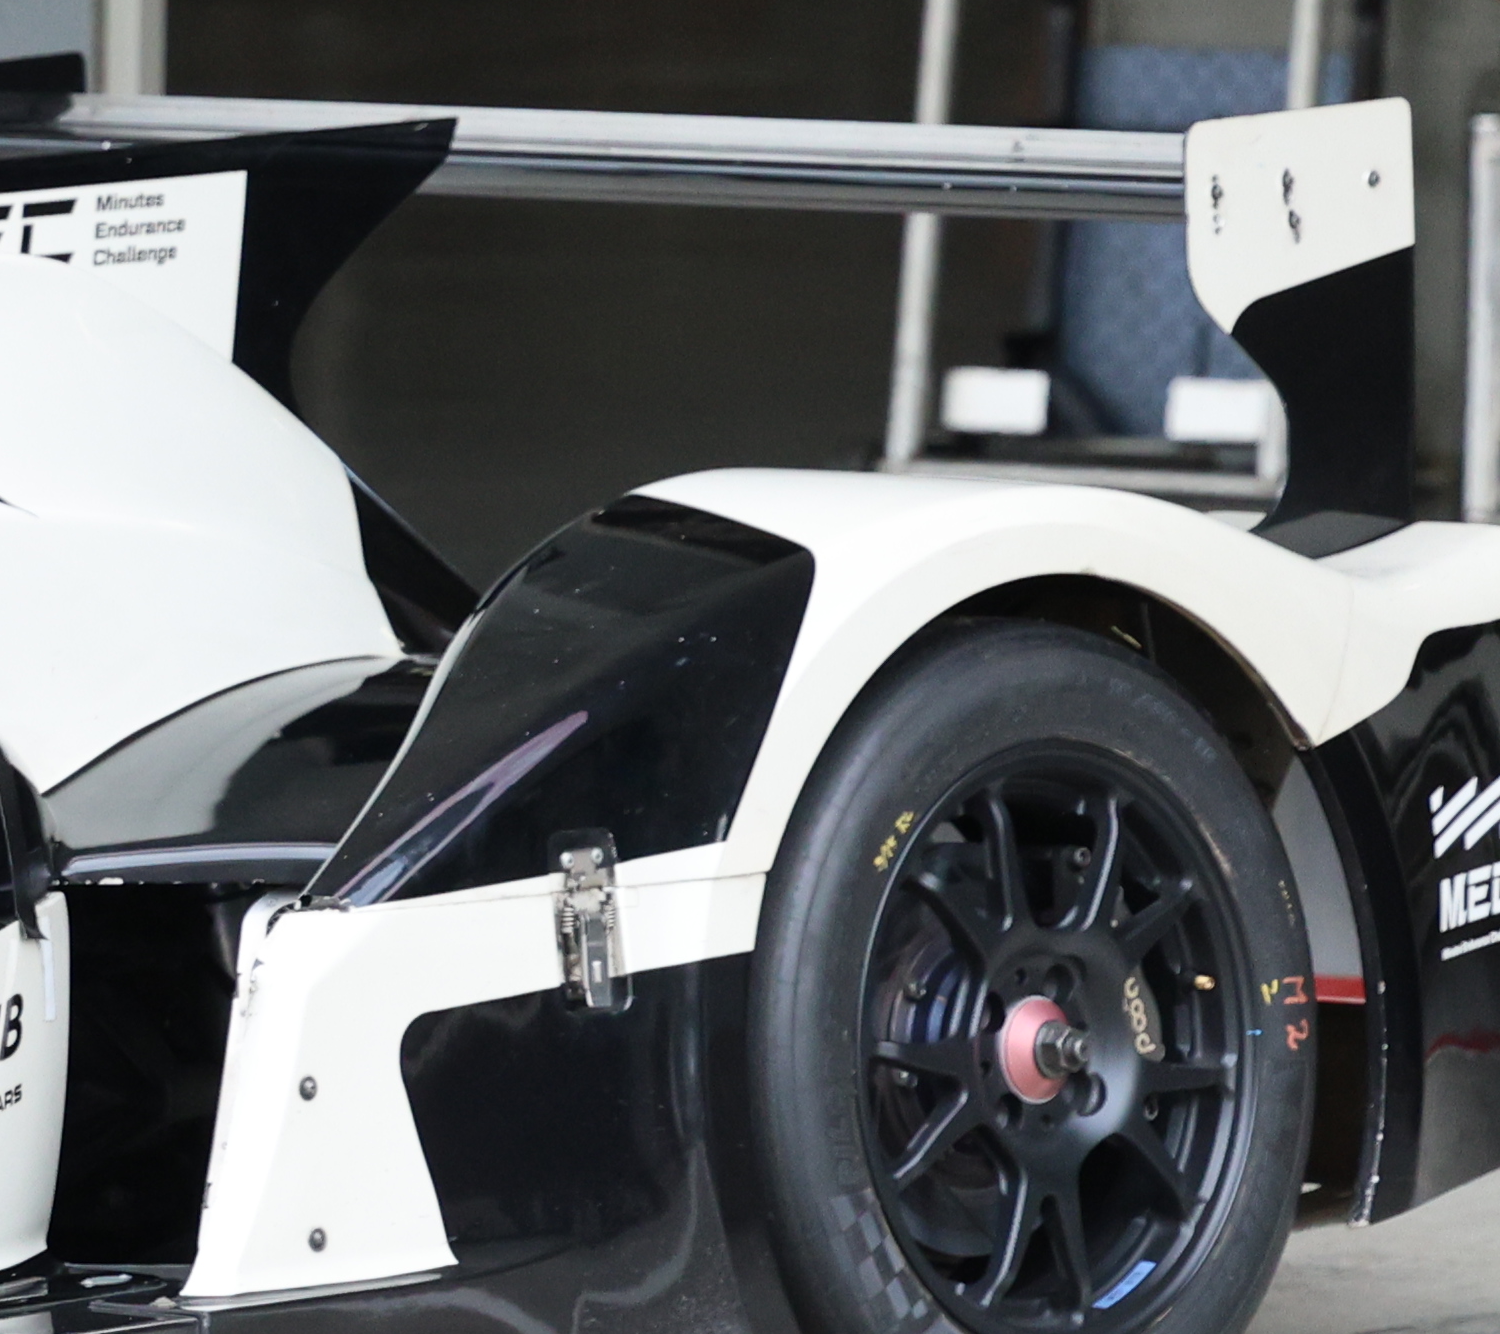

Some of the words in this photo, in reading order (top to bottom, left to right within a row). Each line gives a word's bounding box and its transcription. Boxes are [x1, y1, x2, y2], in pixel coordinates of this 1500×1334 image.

[95, 192, 165, 212] Minutes
[94, 218, 186, 240] Endurance
[92, 245, 178, 267] Challenge
